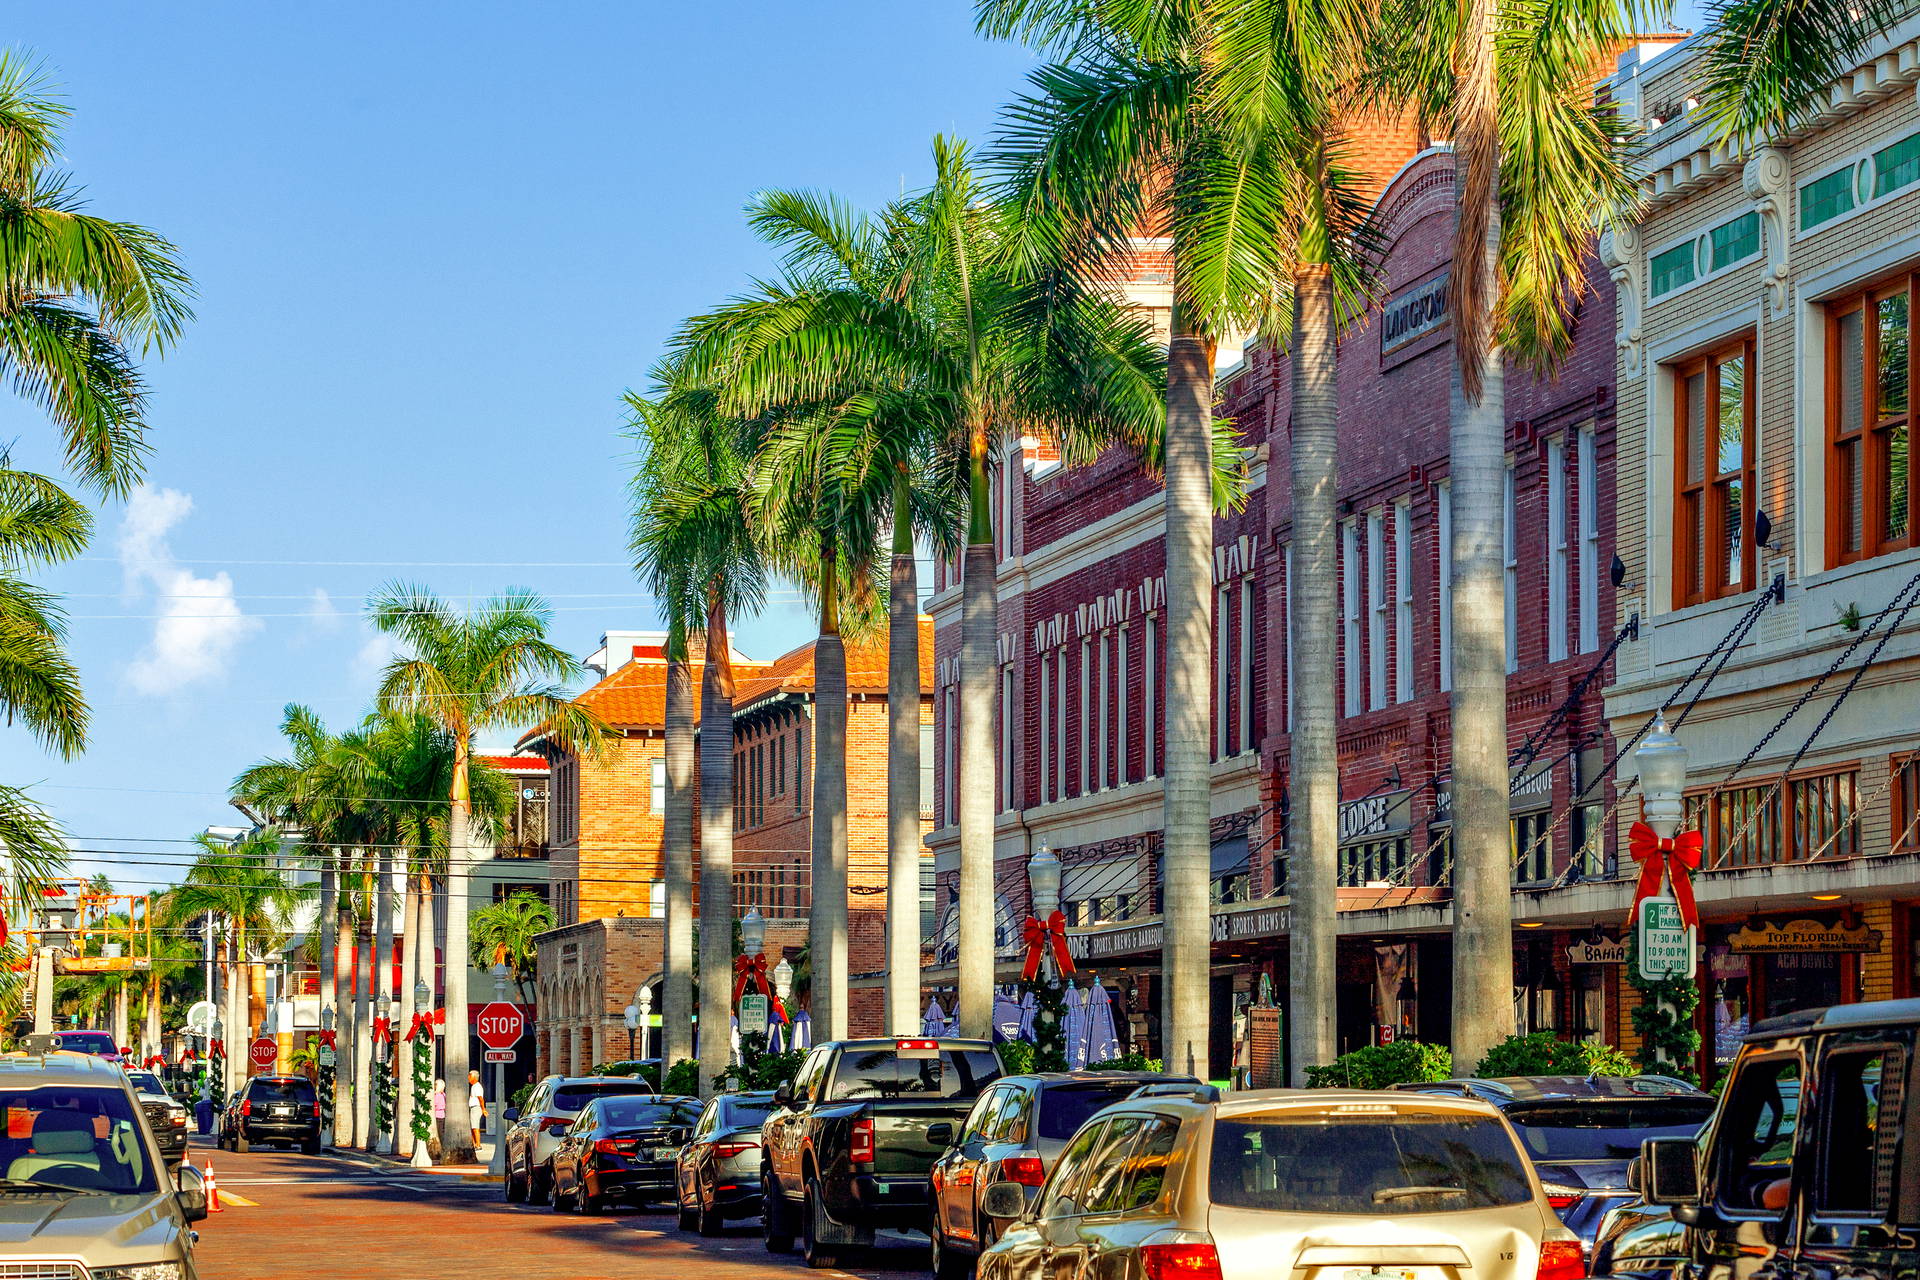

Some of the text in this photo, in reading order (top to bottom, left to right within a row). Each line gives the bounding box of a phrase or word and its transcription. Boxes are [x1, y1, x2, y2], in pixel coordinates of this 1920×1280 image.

[1340, 797, 1386, 838] LODGE
[1649, 909, 1656, 923] 2
[1233, 915, 1256, 936] SPORTS,
[1258, 911, 1278, 932] BREWS
[1280, 911, 1286, 929] &
[1652, 934, 1682, 944] 7:30 AM
[1792, 932, 1846, 943] FLORIDA
[1067, 935, 1089, 960] ODGE
[1093, 935, 1113, 954] SPORTS,
[1114, 932, 1131, 950] BREWS
[1138, 927, 1164, 948] BARBEQU
[1648, 946, 1687, 957] TO 9:00 PM
[1650, 959, 1686, 970] THIS SIDE
[1801, 953, 1834, 969] BOWLS
[480, 1016, 520, 1034] STOP
[252, 1046, 277, 1057] STOP
[488, 1052, 513, 1060] ALL WAY
[1500, 1251, 1514, 1261] V6
